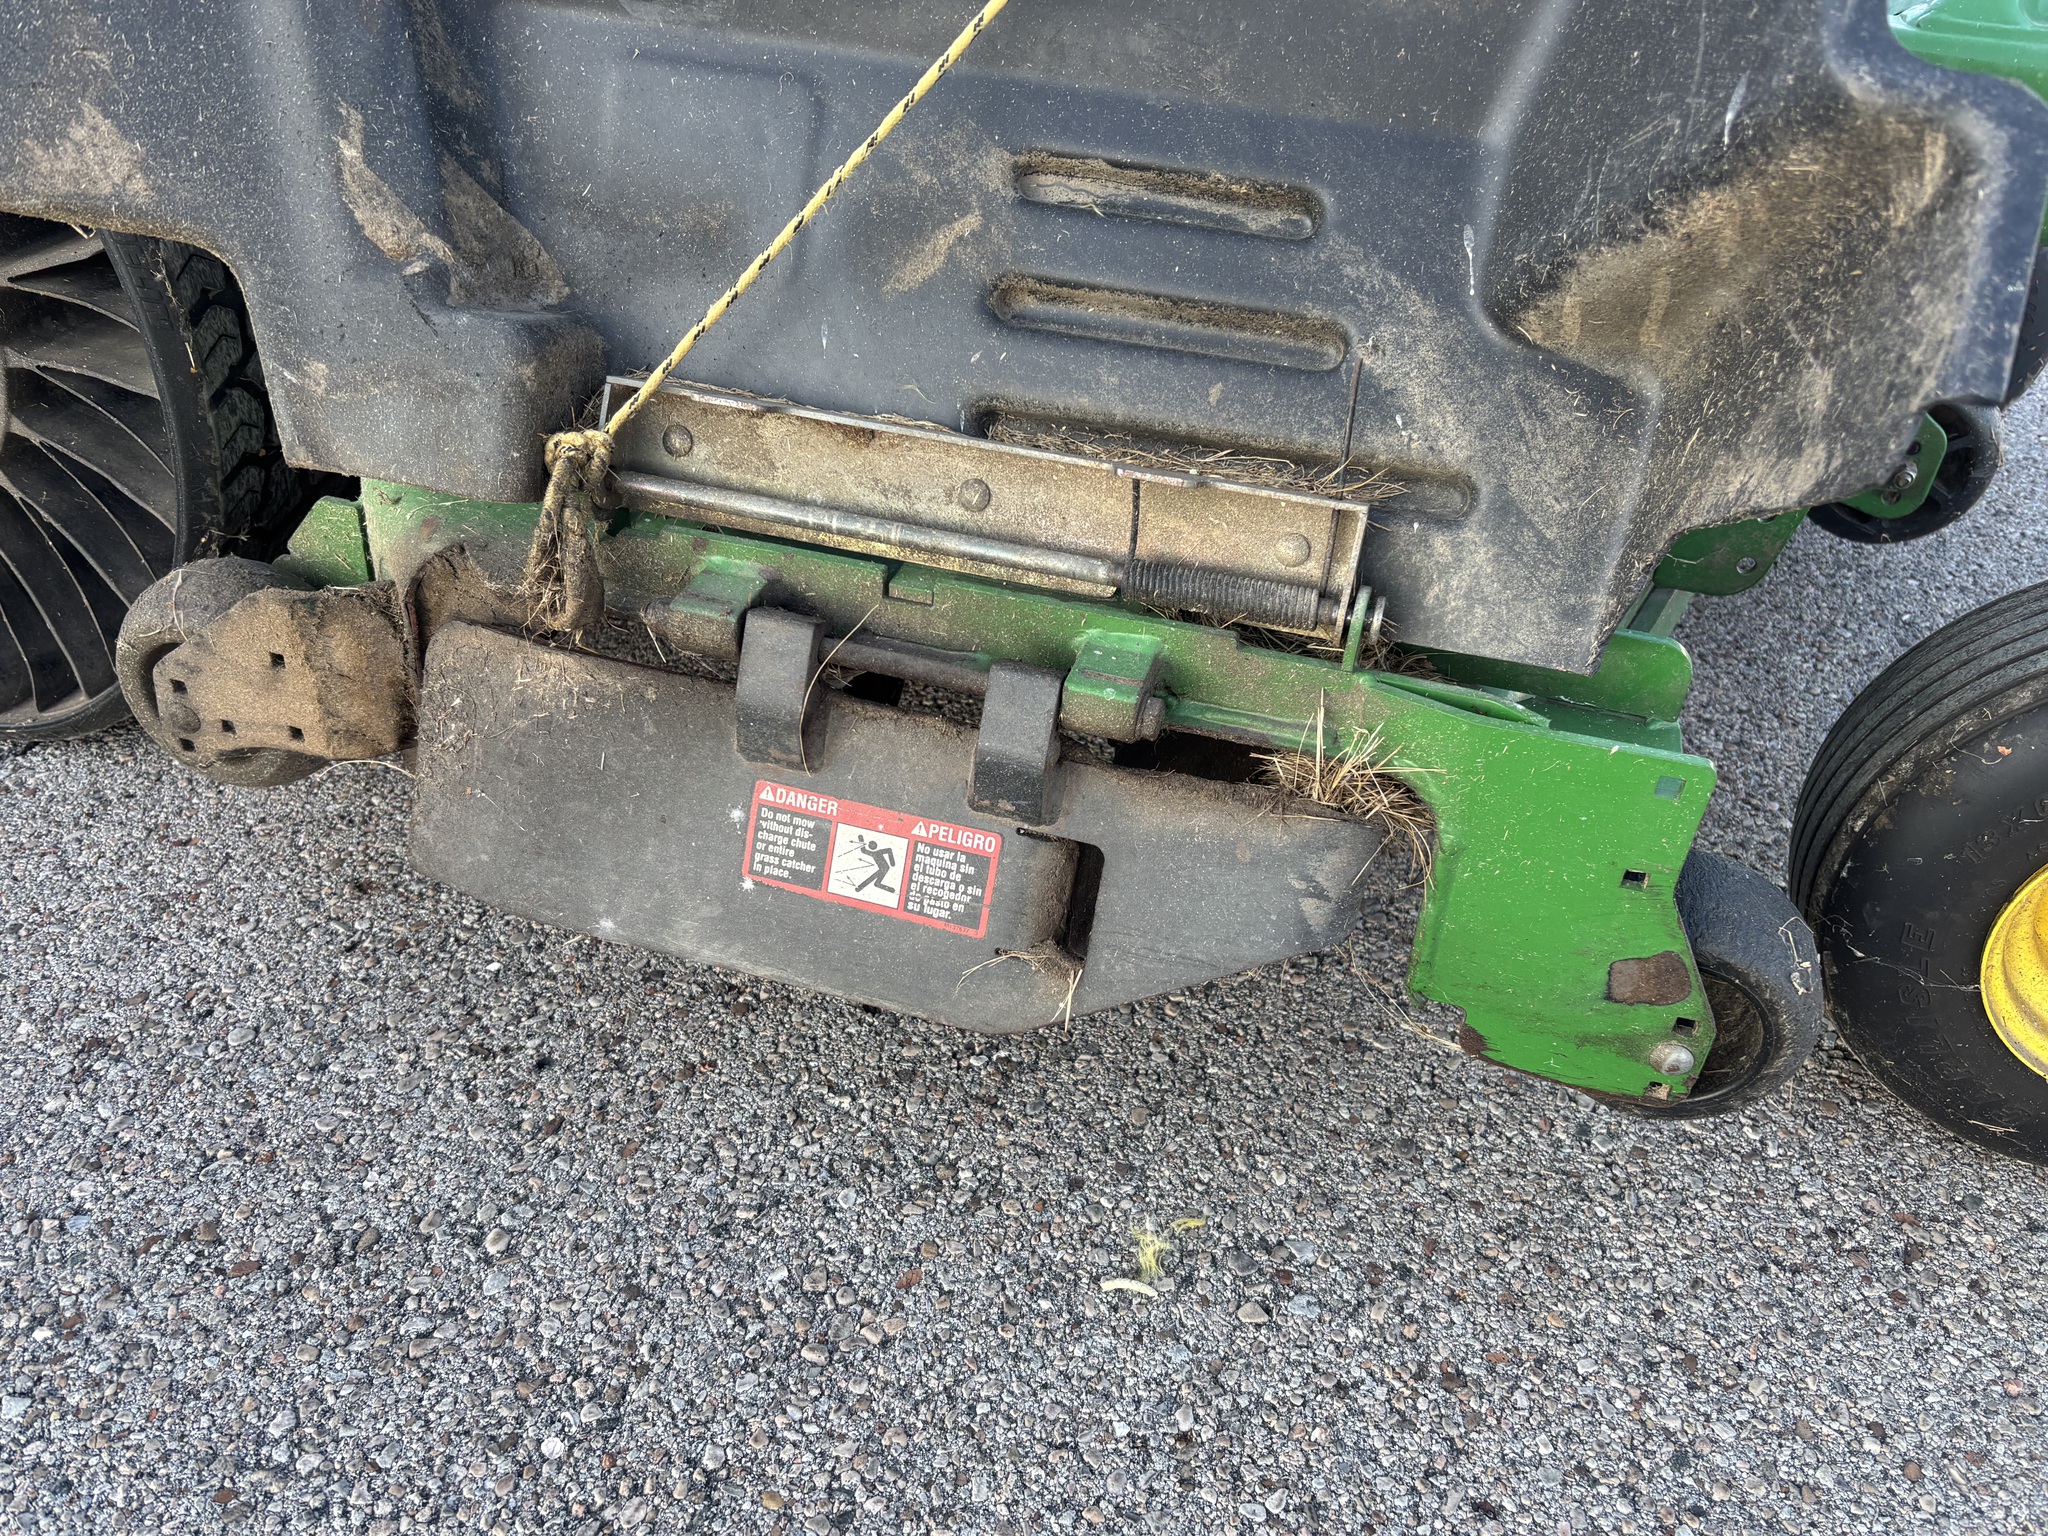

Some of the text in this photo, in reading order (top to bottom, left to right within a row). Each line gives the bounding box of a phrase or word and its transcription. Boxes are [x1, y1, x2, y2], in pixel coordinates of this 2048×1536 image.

[776, 788, 838, 816] DANGER
[761, 808, 815, 828] Do not mow
[758, 830, 816, 851] charge chute
[795, 828, 812, 838] dis-
[928, 823, 996, 852] PELIGRO
[756, 842, 795, 857] or entire
[916, 843, 965, 863] No usar la
[755, 852, 816, 873] grass catcher
[764, 865, 792, 879] place.
[914, 864, 961, 881] el tubo de
[960, 865, 974, 875] sin
[911, 882, 971, 903] el recogedor
[912, 872, 982, 896] descarga o sin
[907, 901, 951, 919] su lugar.
[952, 903, 964, 913] en
